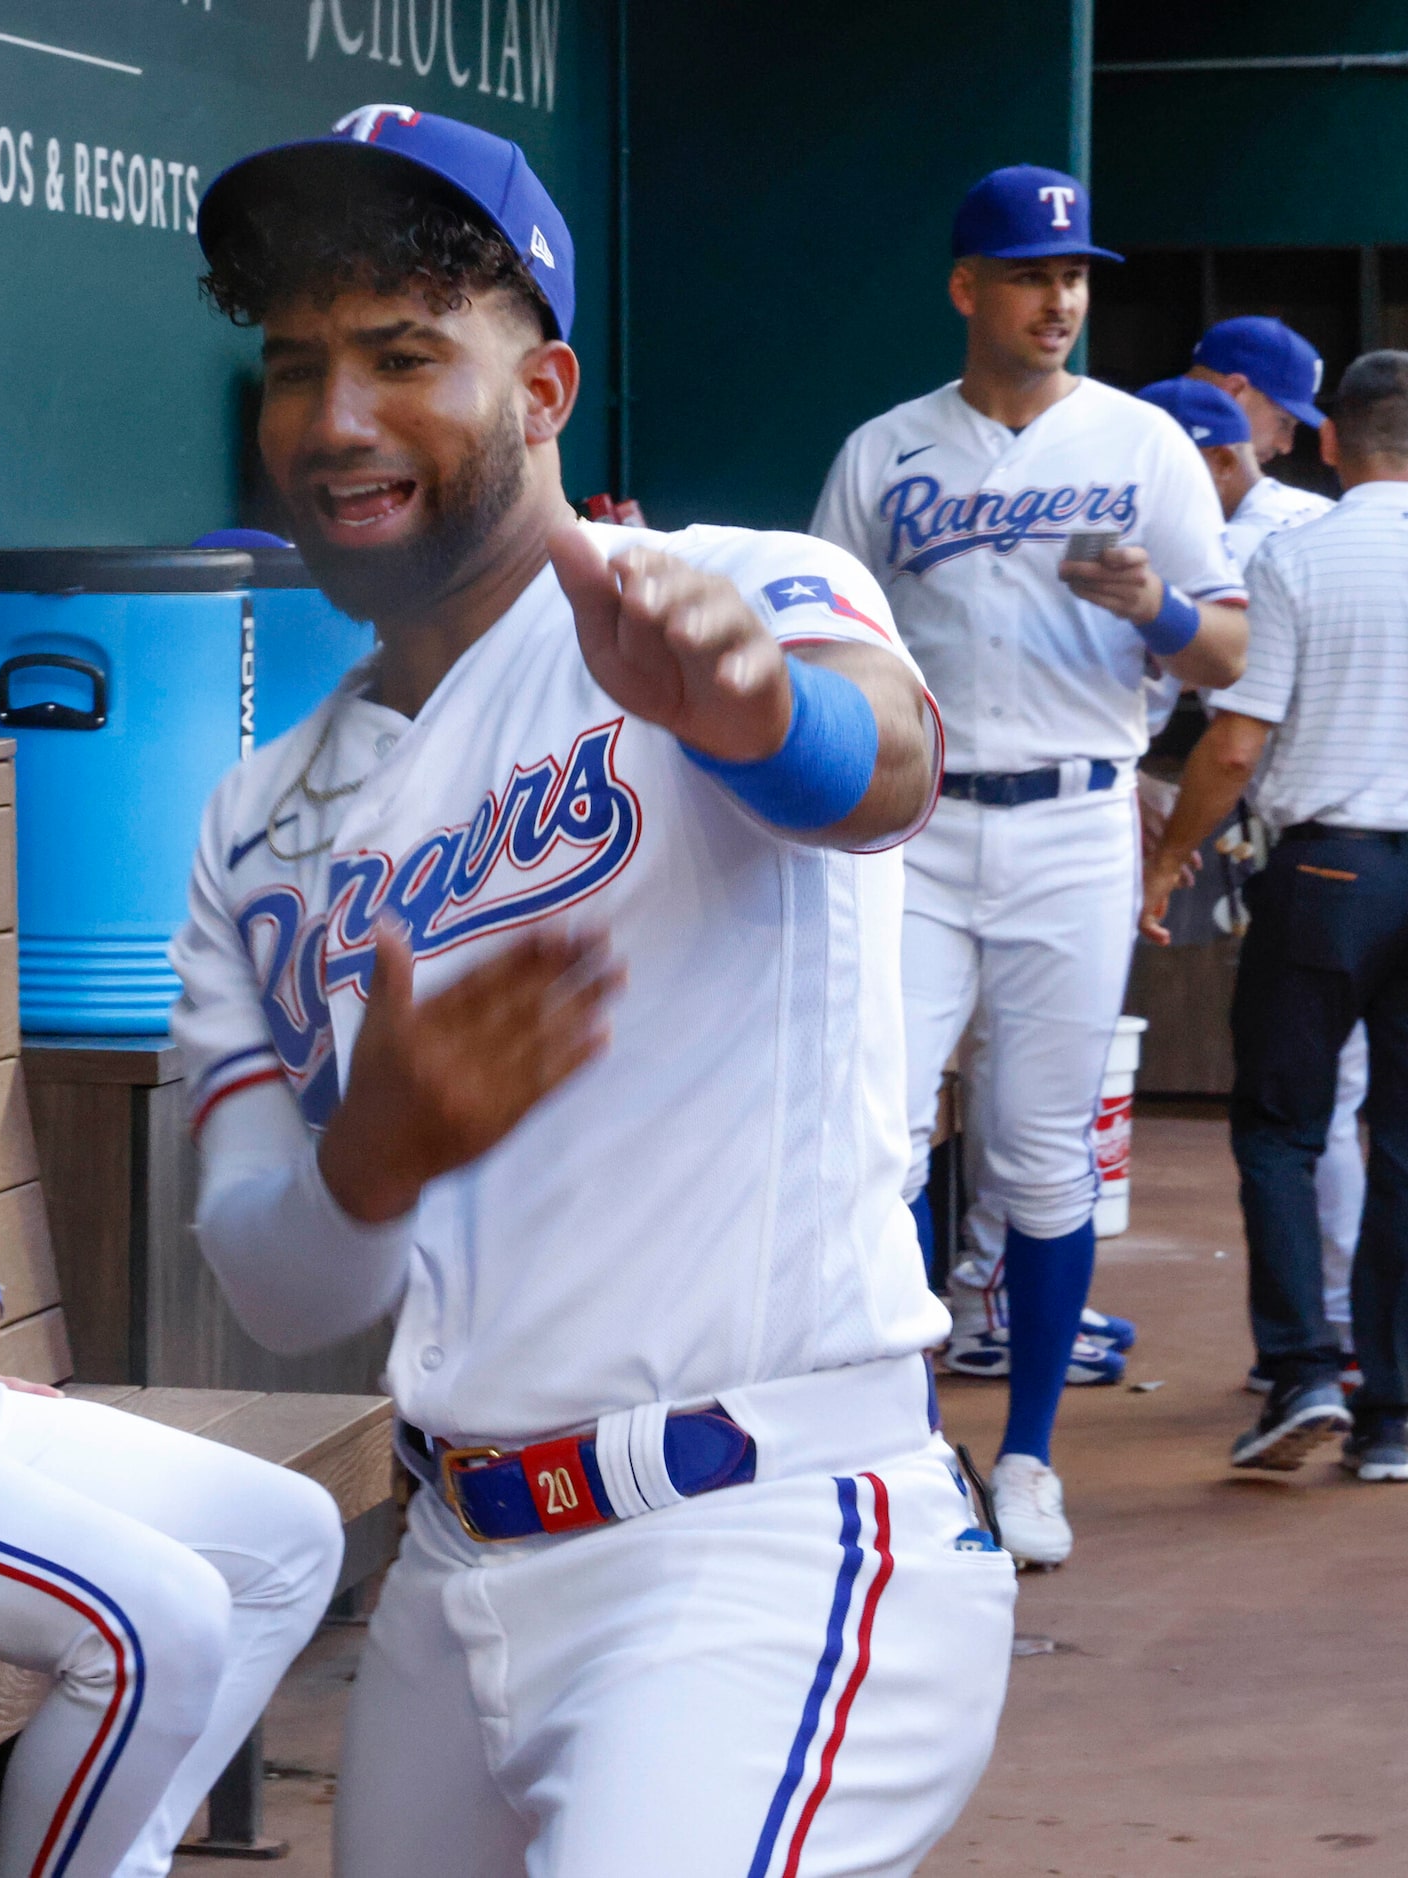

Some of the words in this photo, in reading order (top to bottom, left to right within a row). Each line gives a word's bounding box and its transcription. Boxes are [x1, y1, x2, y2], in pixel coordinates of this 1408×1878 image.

[45, 137, 66, 211] &
[75, 146, 200, 235] RESORTS
[1038, 186, 1075, 231] T
[878, 473, 1141, 575] Rangers
[538, 1467, 579, 1514] 20
